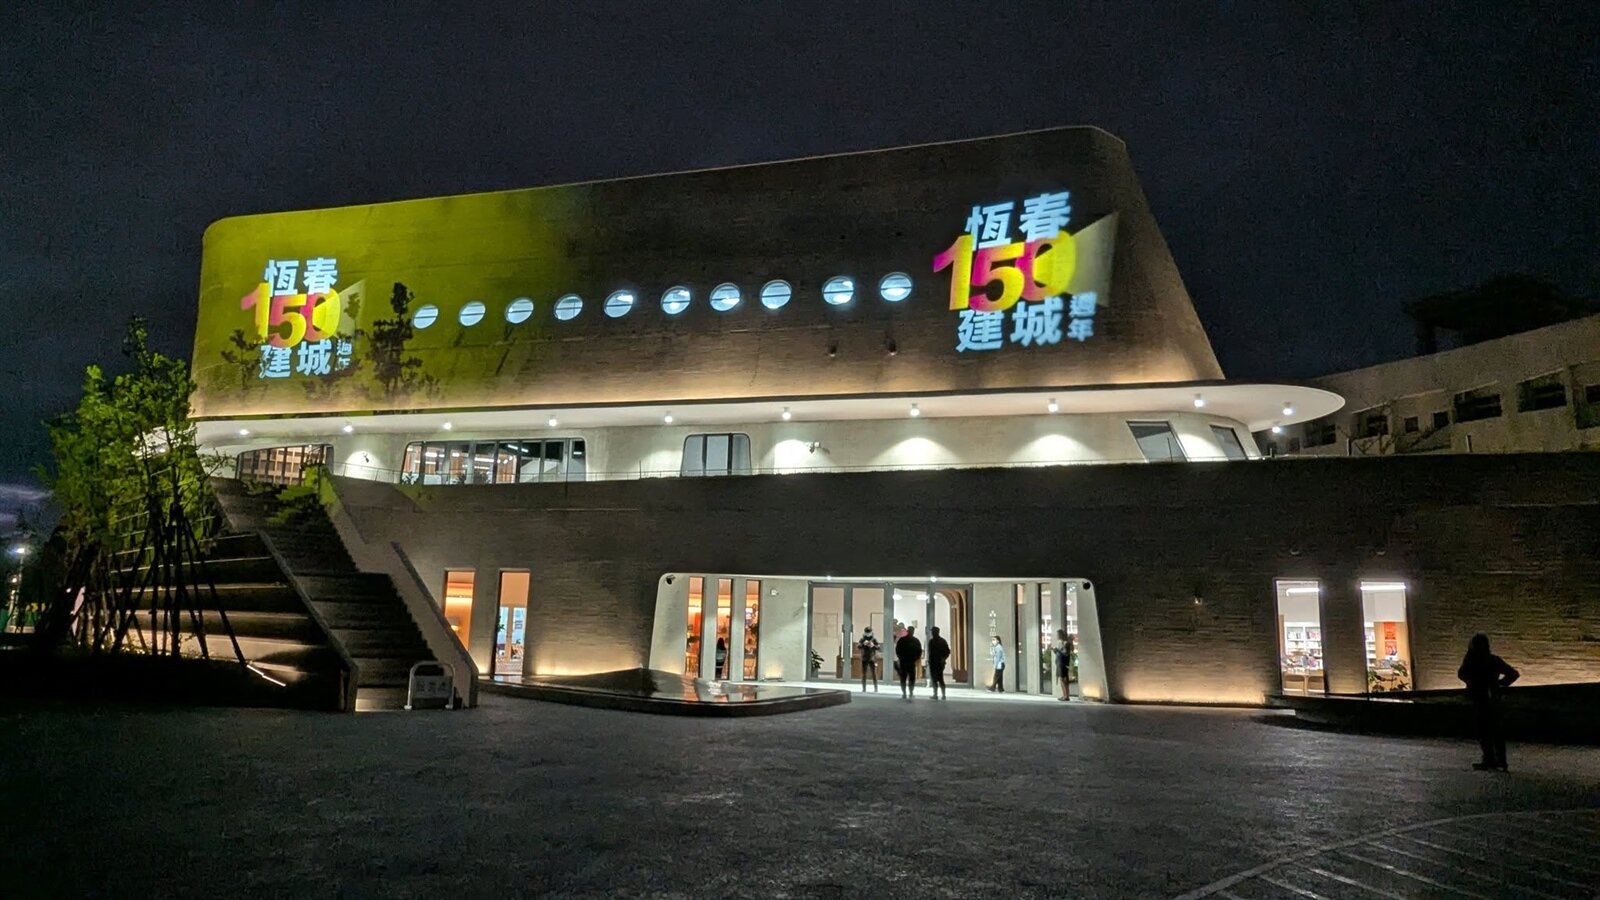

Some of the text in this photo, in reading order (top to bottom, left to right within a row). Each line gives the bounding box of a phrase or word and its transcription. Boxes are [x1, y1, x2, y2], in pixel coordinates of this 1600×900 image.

[964, 191, 1071, 251] 恆春
[264, 257, 337, 297] 恆春
[933, 230, 1076, 312] 150
[241, 282, 340, 347] 150
[956, 296, 1063, 352] 建城
[1067, 292, 1097, 341] 週年
[259, 338, 331, 378] 建城
